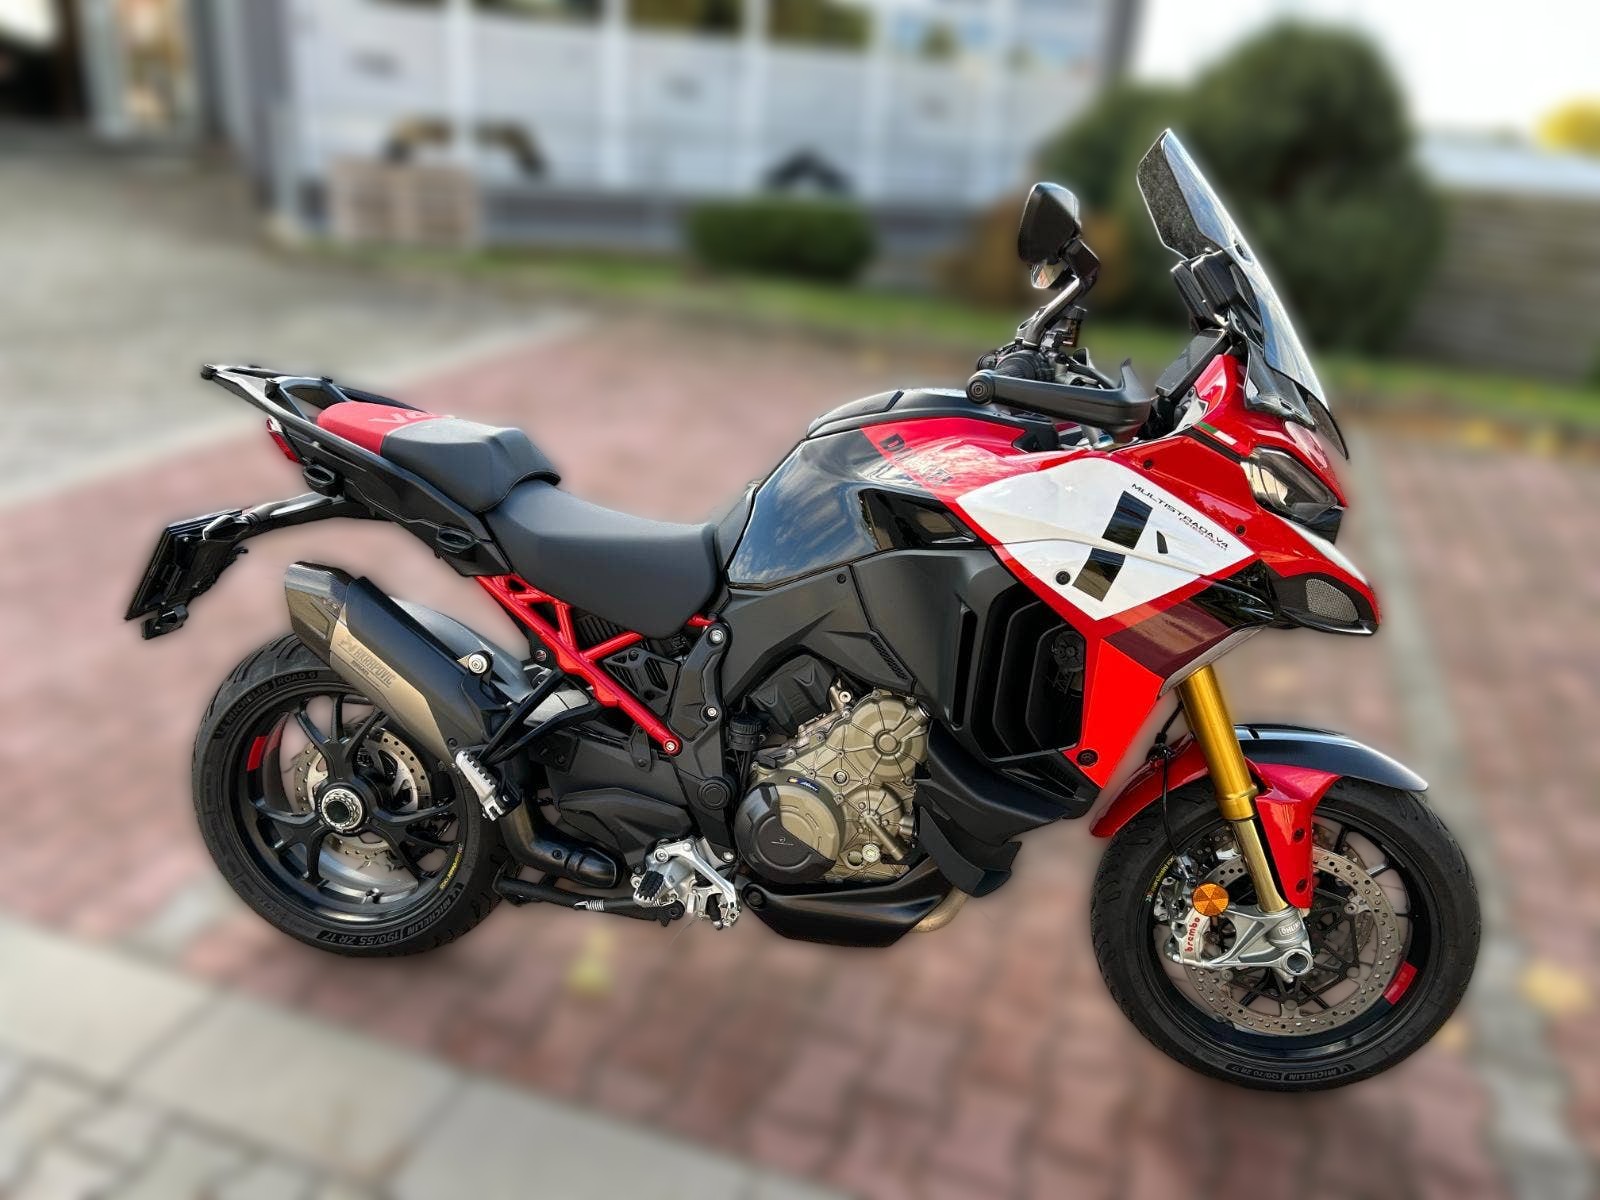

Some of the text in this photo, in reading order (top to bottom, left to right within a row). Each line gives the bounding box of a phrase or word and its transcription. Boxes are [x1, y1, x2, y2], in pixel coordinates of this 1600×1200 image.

[1132, 483, 1229, 548] MULTISTRADA V4
[227, 682, 270, 723] MICHELIN
[275, 672, 306, 686] ROAD
[322, 894, 452, 946] MICHELIN 190/55 ZR 17
[1185, 916, 1201, 953] brembo
[1289, 1067, 1337, 1080] MICHELIN
